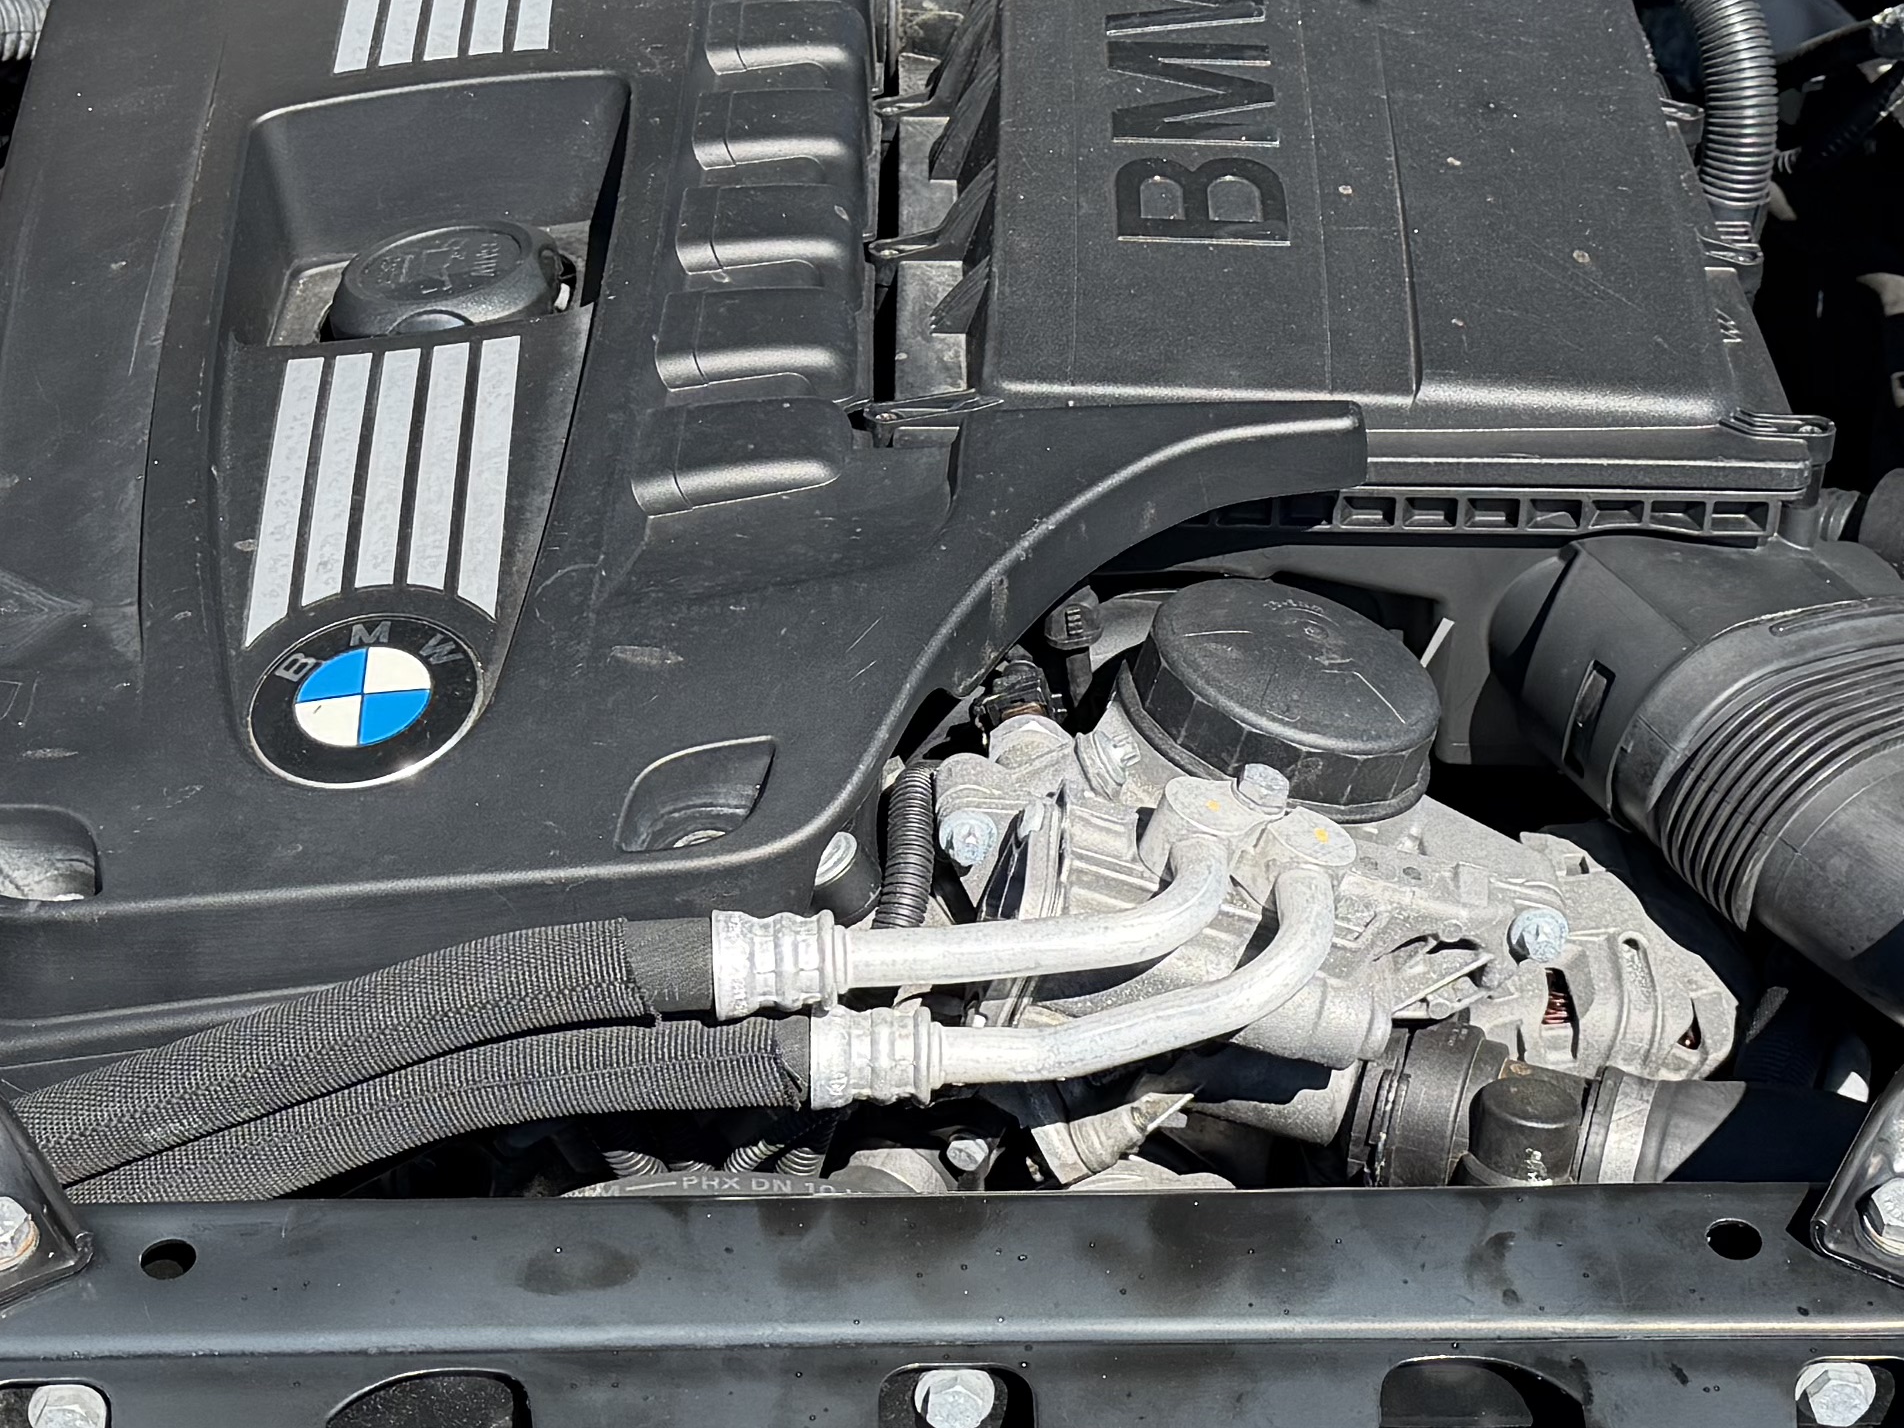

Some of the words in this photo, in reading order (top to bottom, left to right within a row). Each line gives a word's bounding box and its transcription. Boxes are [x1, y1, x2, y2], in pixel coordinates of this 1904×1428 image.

[274, 621, 464, 682] BMW
[682, 1176, 741, 1191] PHX
[751, 1178, 792, 1192] DN
